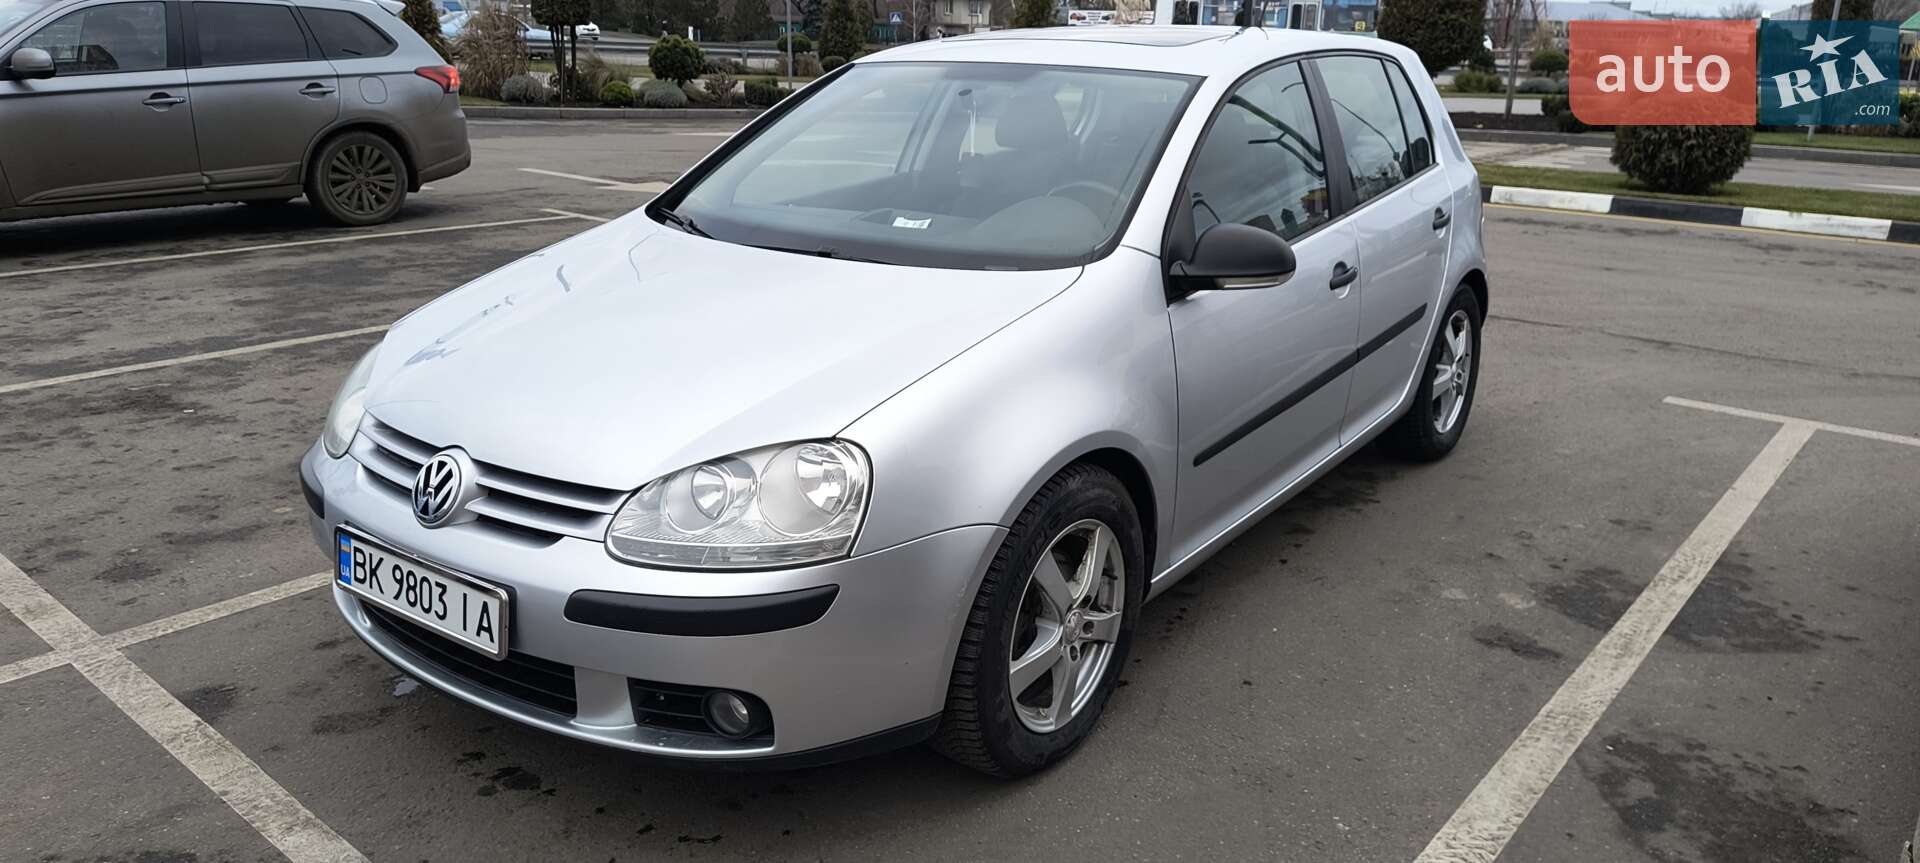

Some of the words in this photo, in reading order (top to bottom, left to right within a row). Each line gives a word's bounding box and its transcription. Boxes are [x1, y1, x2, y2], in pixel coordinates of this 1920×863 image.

[340, 564, 350, 579] UA
[353, 546, 384, 595] BK
[392, 564, 448, 621] 9803
[462, 592, 495, 643] IA
